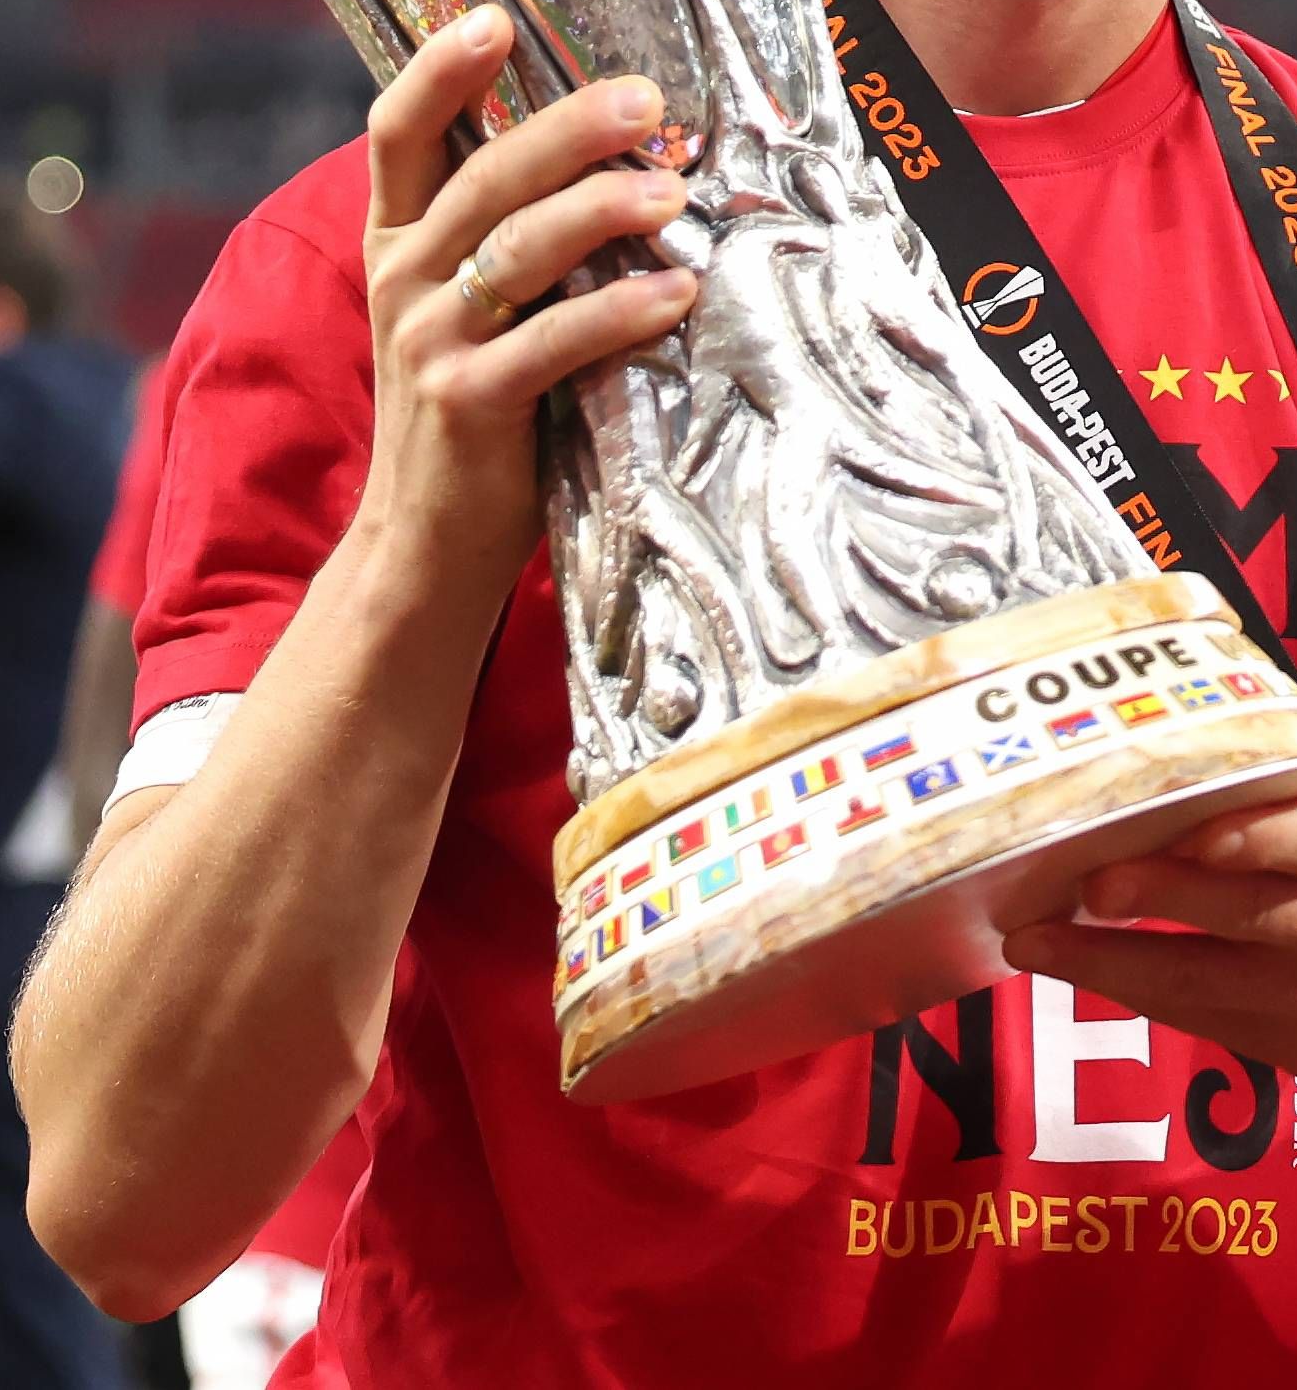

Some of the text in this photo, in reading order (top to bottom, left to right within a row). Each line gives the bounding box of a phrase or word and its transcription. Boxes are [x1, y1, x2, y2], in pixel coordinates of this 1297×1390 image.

[848, 71, 941, 180] 2023
[1205, 42, 1277, 157] FINAL
[1116, 491, 1183, 570] FIN
[975, 637, 1199, 723] COUPE
[846, 1191, 1279, 1258] BUDAPEST 2023
